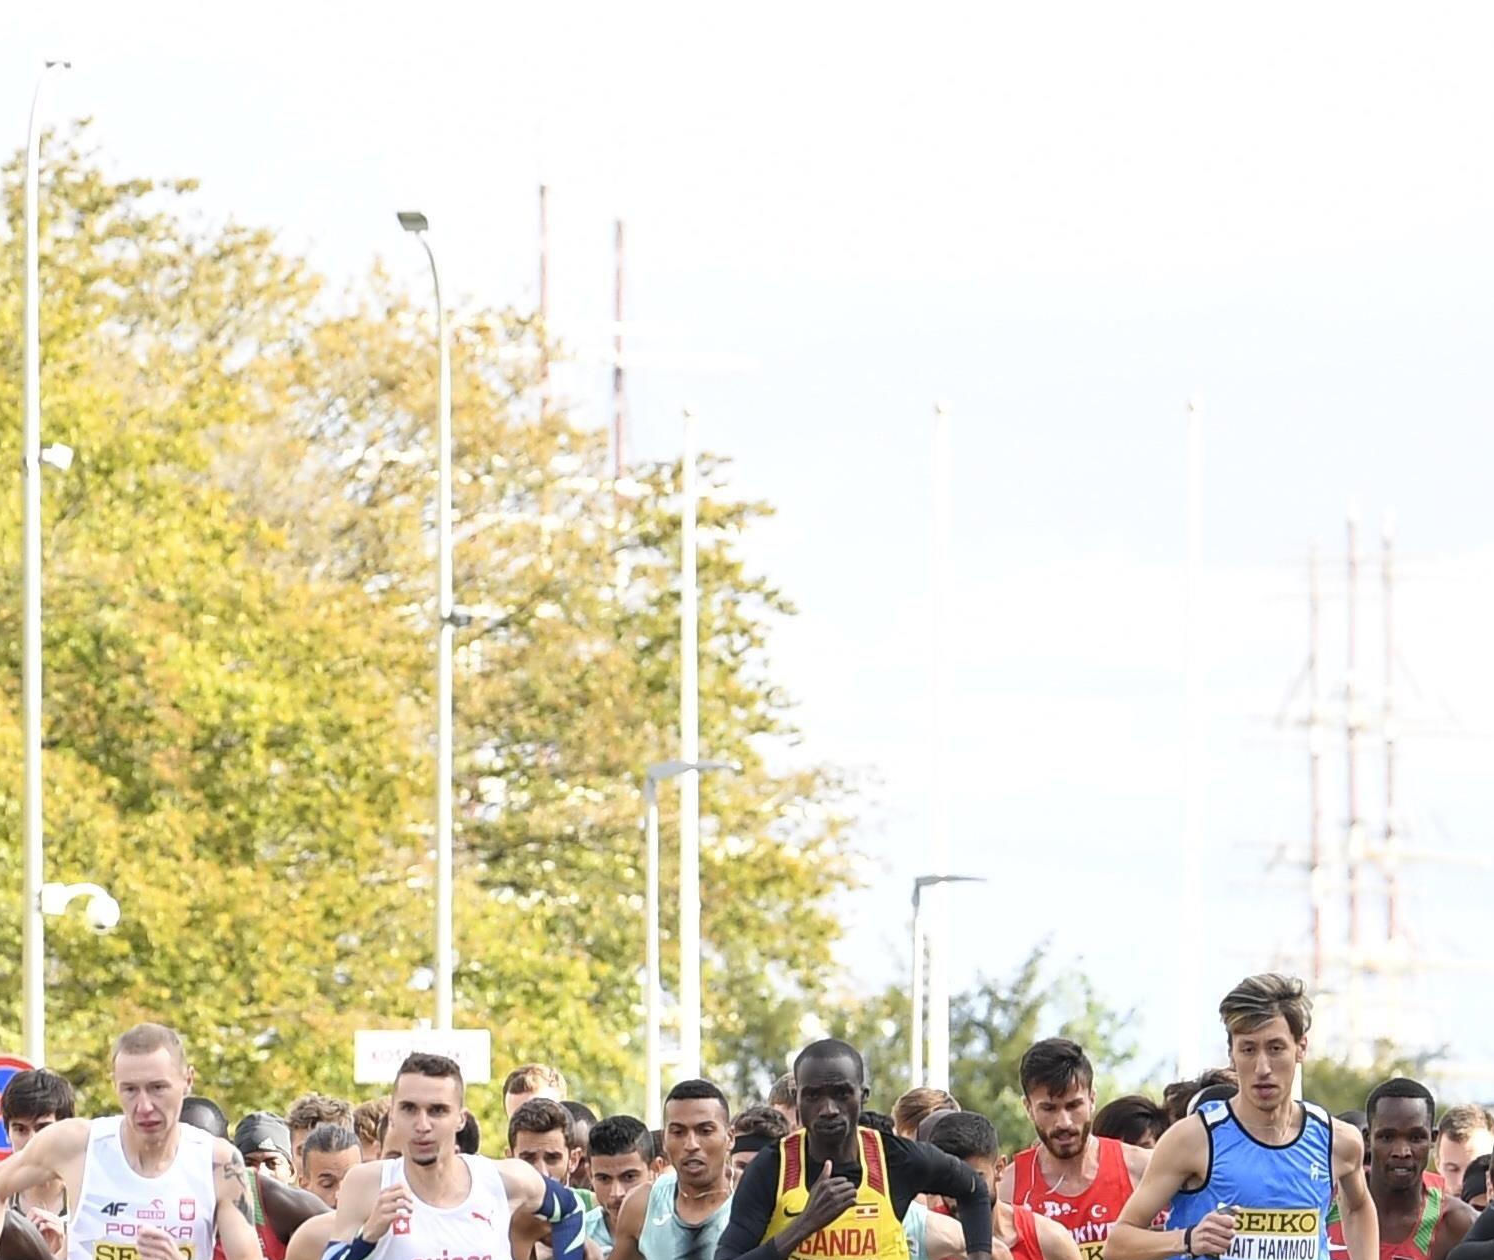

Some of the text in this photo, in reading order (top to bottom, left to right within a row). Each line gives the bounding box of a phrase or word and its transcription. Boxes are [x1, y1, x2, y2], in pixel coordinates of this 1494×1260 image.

[1235, 1212, 1317, 1233] SEIKO
[798, 1228, 878, 1258] GANDA
[1257, 1238, 1316, 1260] HAMMOU
